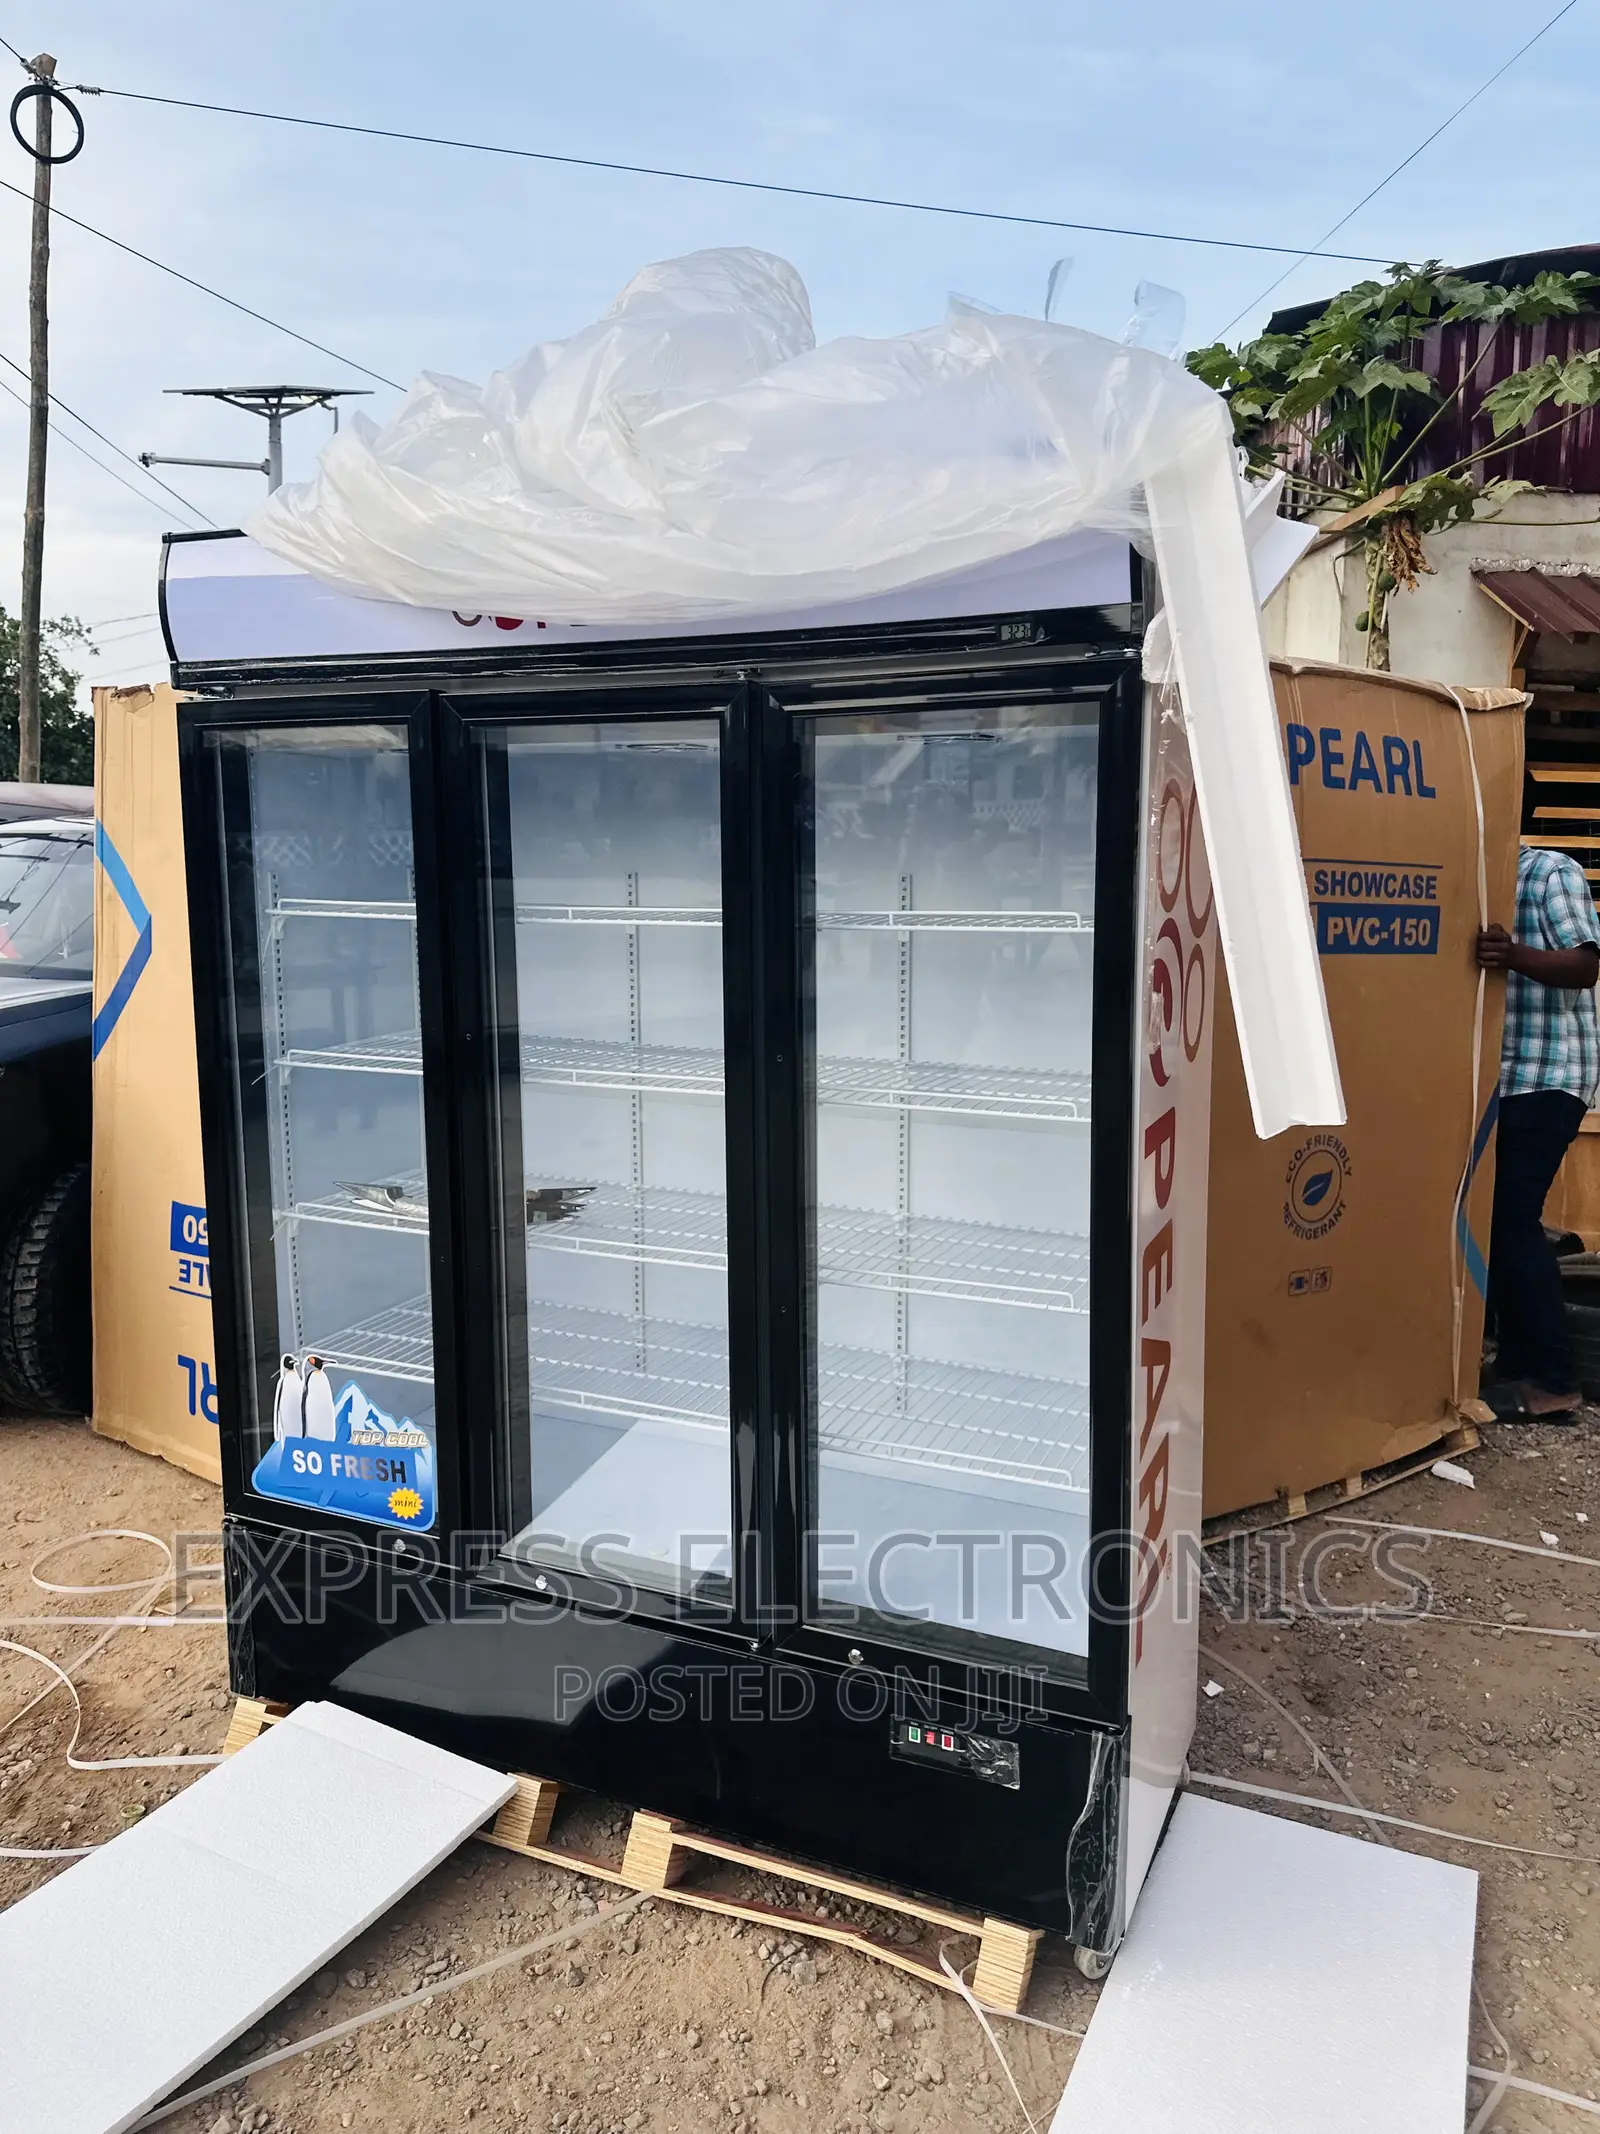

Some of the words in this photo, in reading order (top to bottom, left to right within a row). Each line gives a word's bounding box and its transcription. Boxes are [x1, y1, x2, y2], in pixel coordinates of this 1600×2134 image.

[1286, 723, 1436, 799] PEARL
[1313, 869, 1437, 899] SHOWCASE
[1327, 916, 1431, 946] PVC-150
[1285, 1134, 1352, 1184] ECO-FRIENDLY
[1283, 1200, 1347, 1241] REFRIGERANT
[1135, 1106, 1176, 1669] PEARL
[352, 1430, 385, 1446] TOP
[385, 1432, 430, 1448] COOL
[292, 1449, 323, 1475] SO
[330, 1453, 407, 1484] FRESH
[394, 1493, 418, 1509] mini
